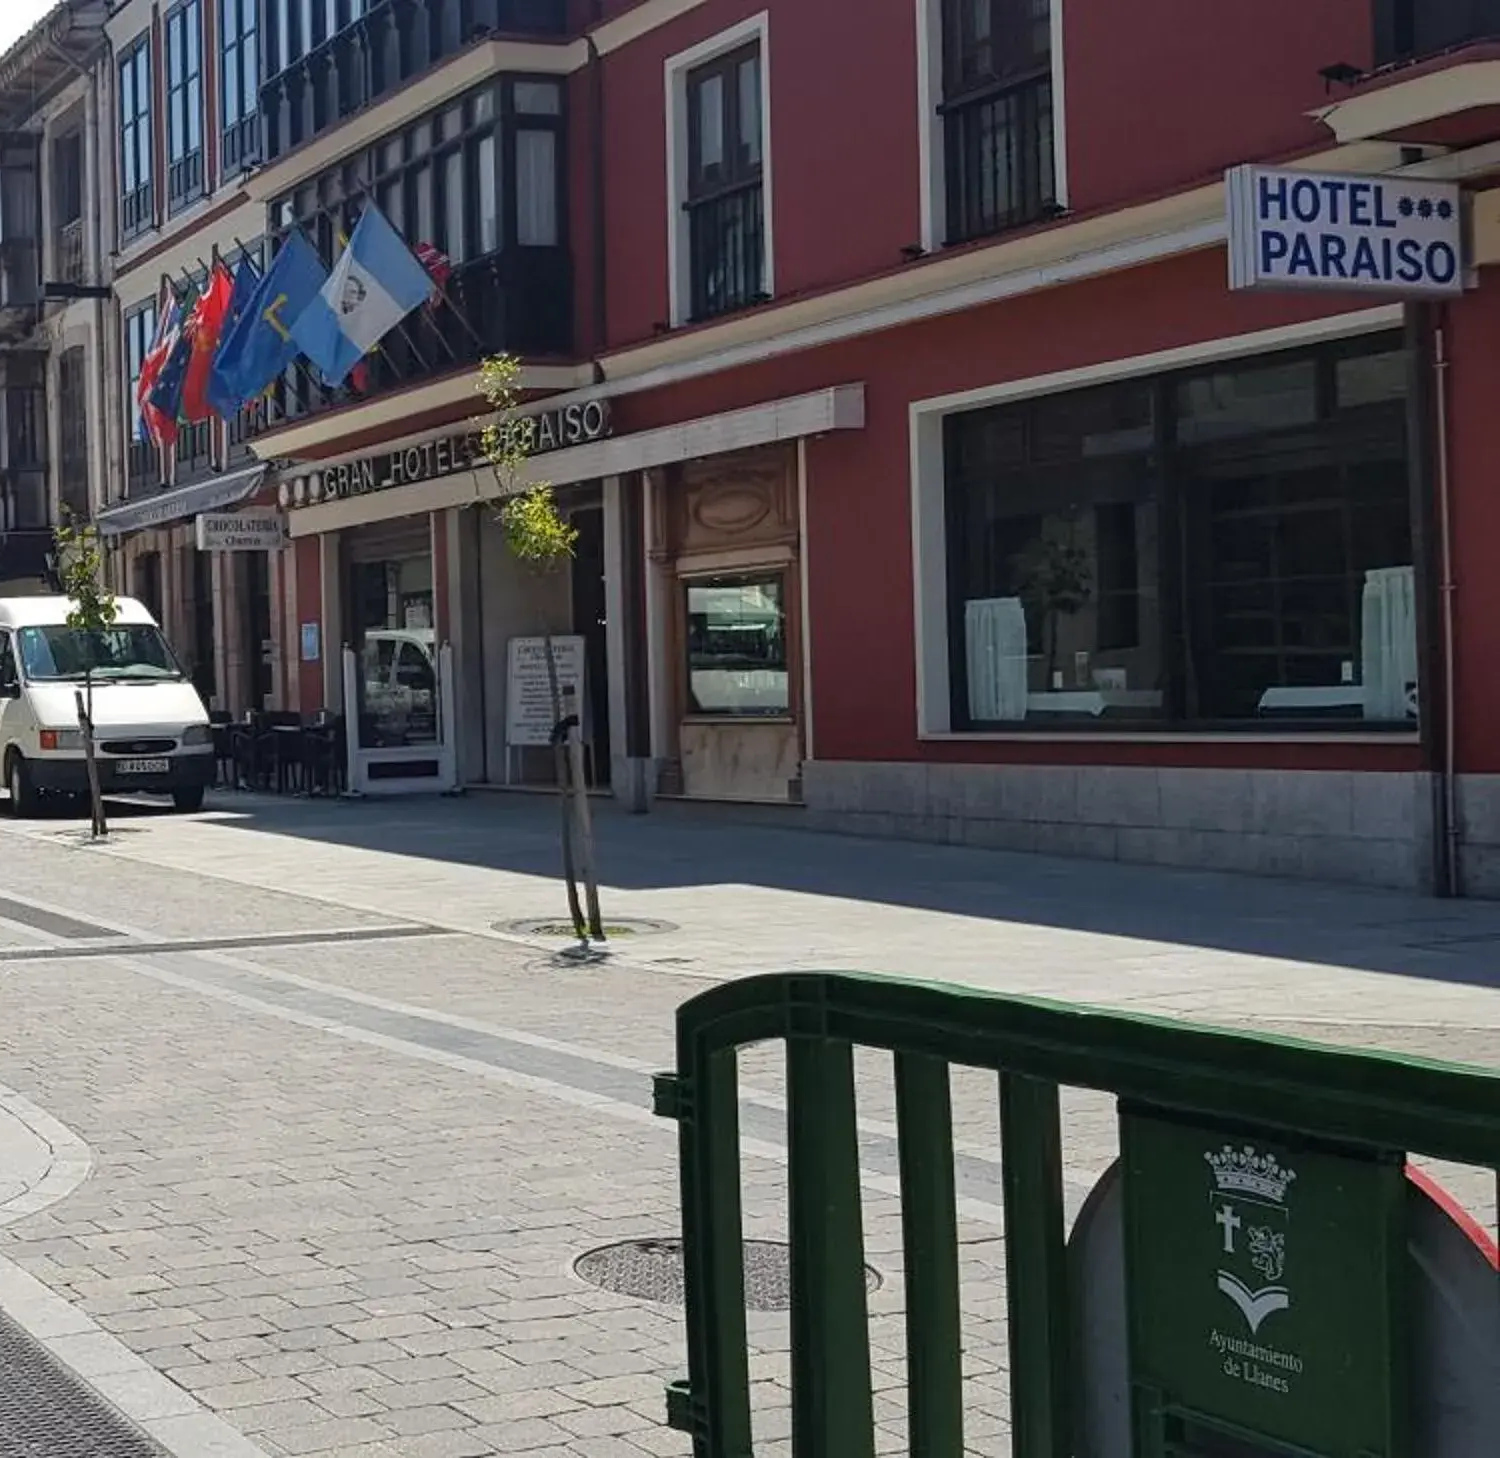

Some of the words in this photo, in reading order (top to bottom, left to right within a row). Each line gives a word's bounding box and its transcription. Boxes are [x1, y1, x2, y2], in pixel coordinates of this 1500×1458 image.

[1258, 175, 1398, 229] HOTEL
[1260, 230, 1456, 284] PARAISO
[323, 457, 376, 497] GRAN
[389, 435, 464, 484] HOTEL
[484, 400, 603, 456] ARAISO
[1209, 1328, 1303, 1373] Ayuntamiento
[1222, 1356, 1241, 1377] de
[1242, 1361, 1289, 1393] Llanes
